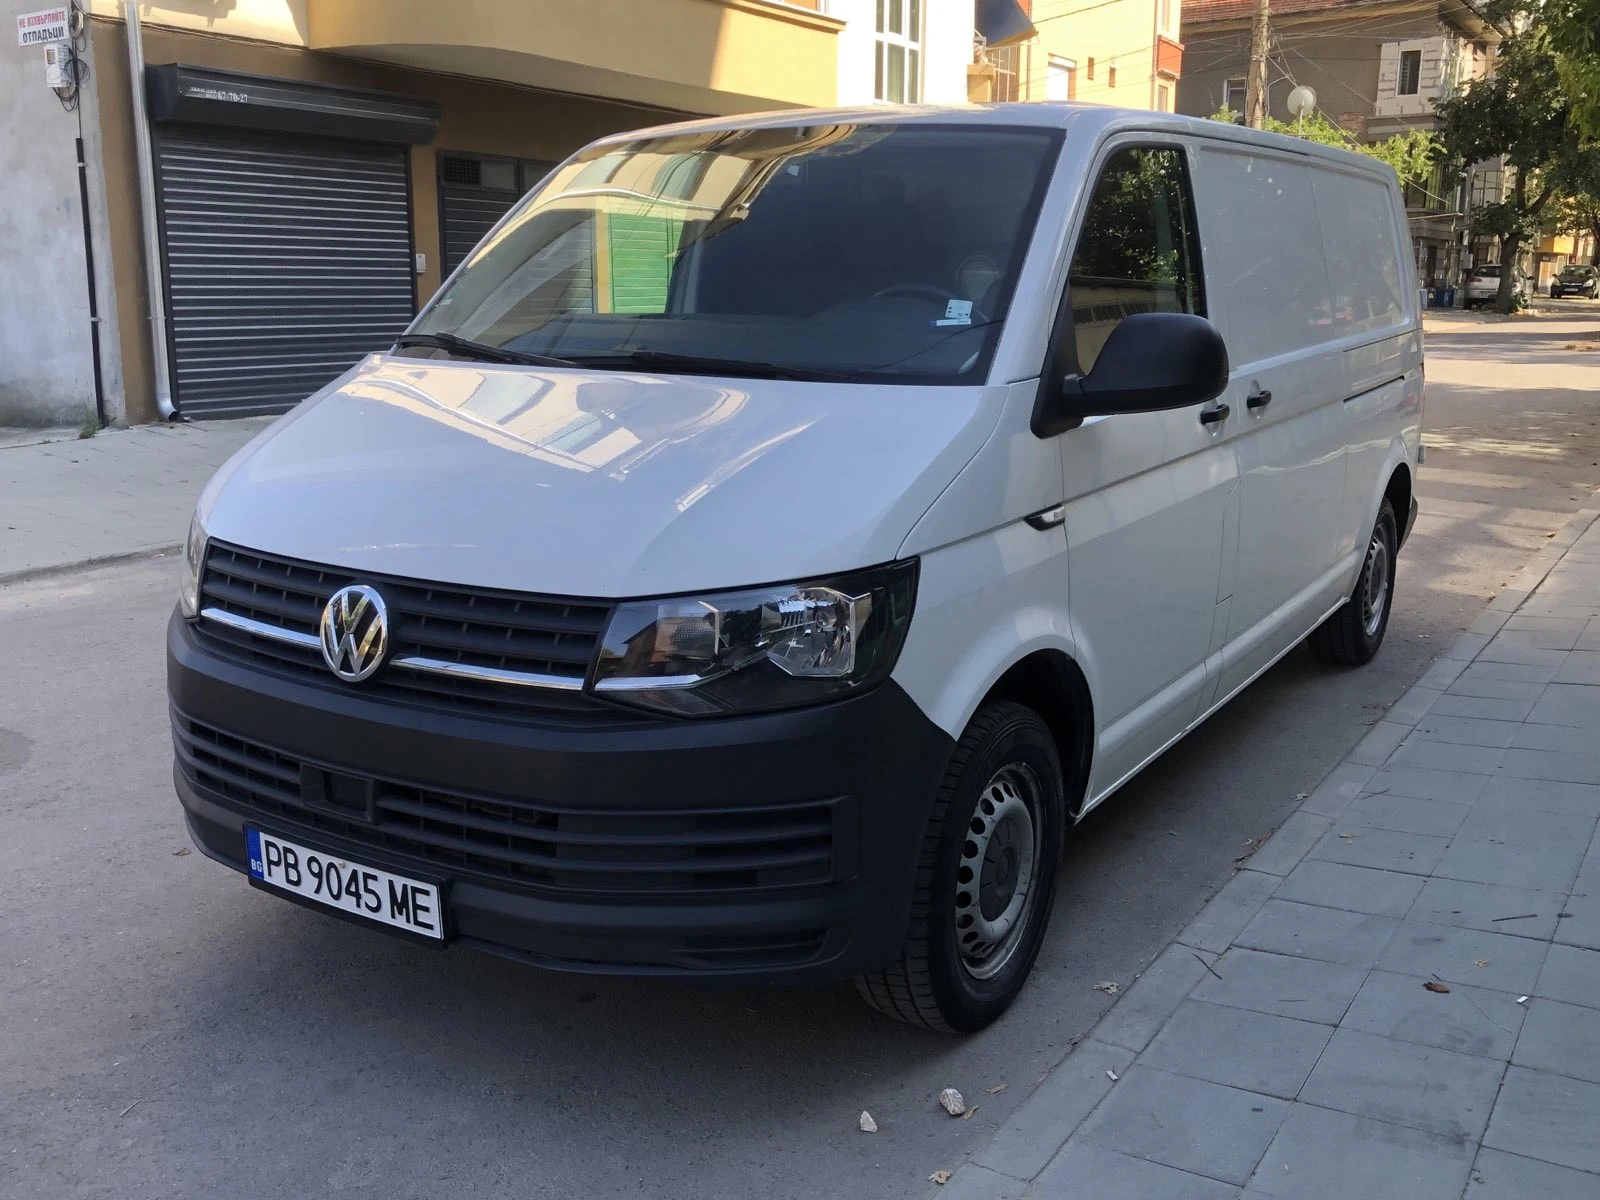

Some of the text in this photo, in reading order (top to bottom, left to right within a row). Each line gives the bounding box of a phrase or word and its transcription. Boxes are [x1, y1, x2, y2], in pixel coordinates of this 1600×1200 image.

[18, 18, 26, 28] НЕ
[22, 26, 64, 43] ОТПАДЪЦИ
[250, 858, 263, 873] BG
[264, 839, 434, 931] PB 9045 ME
